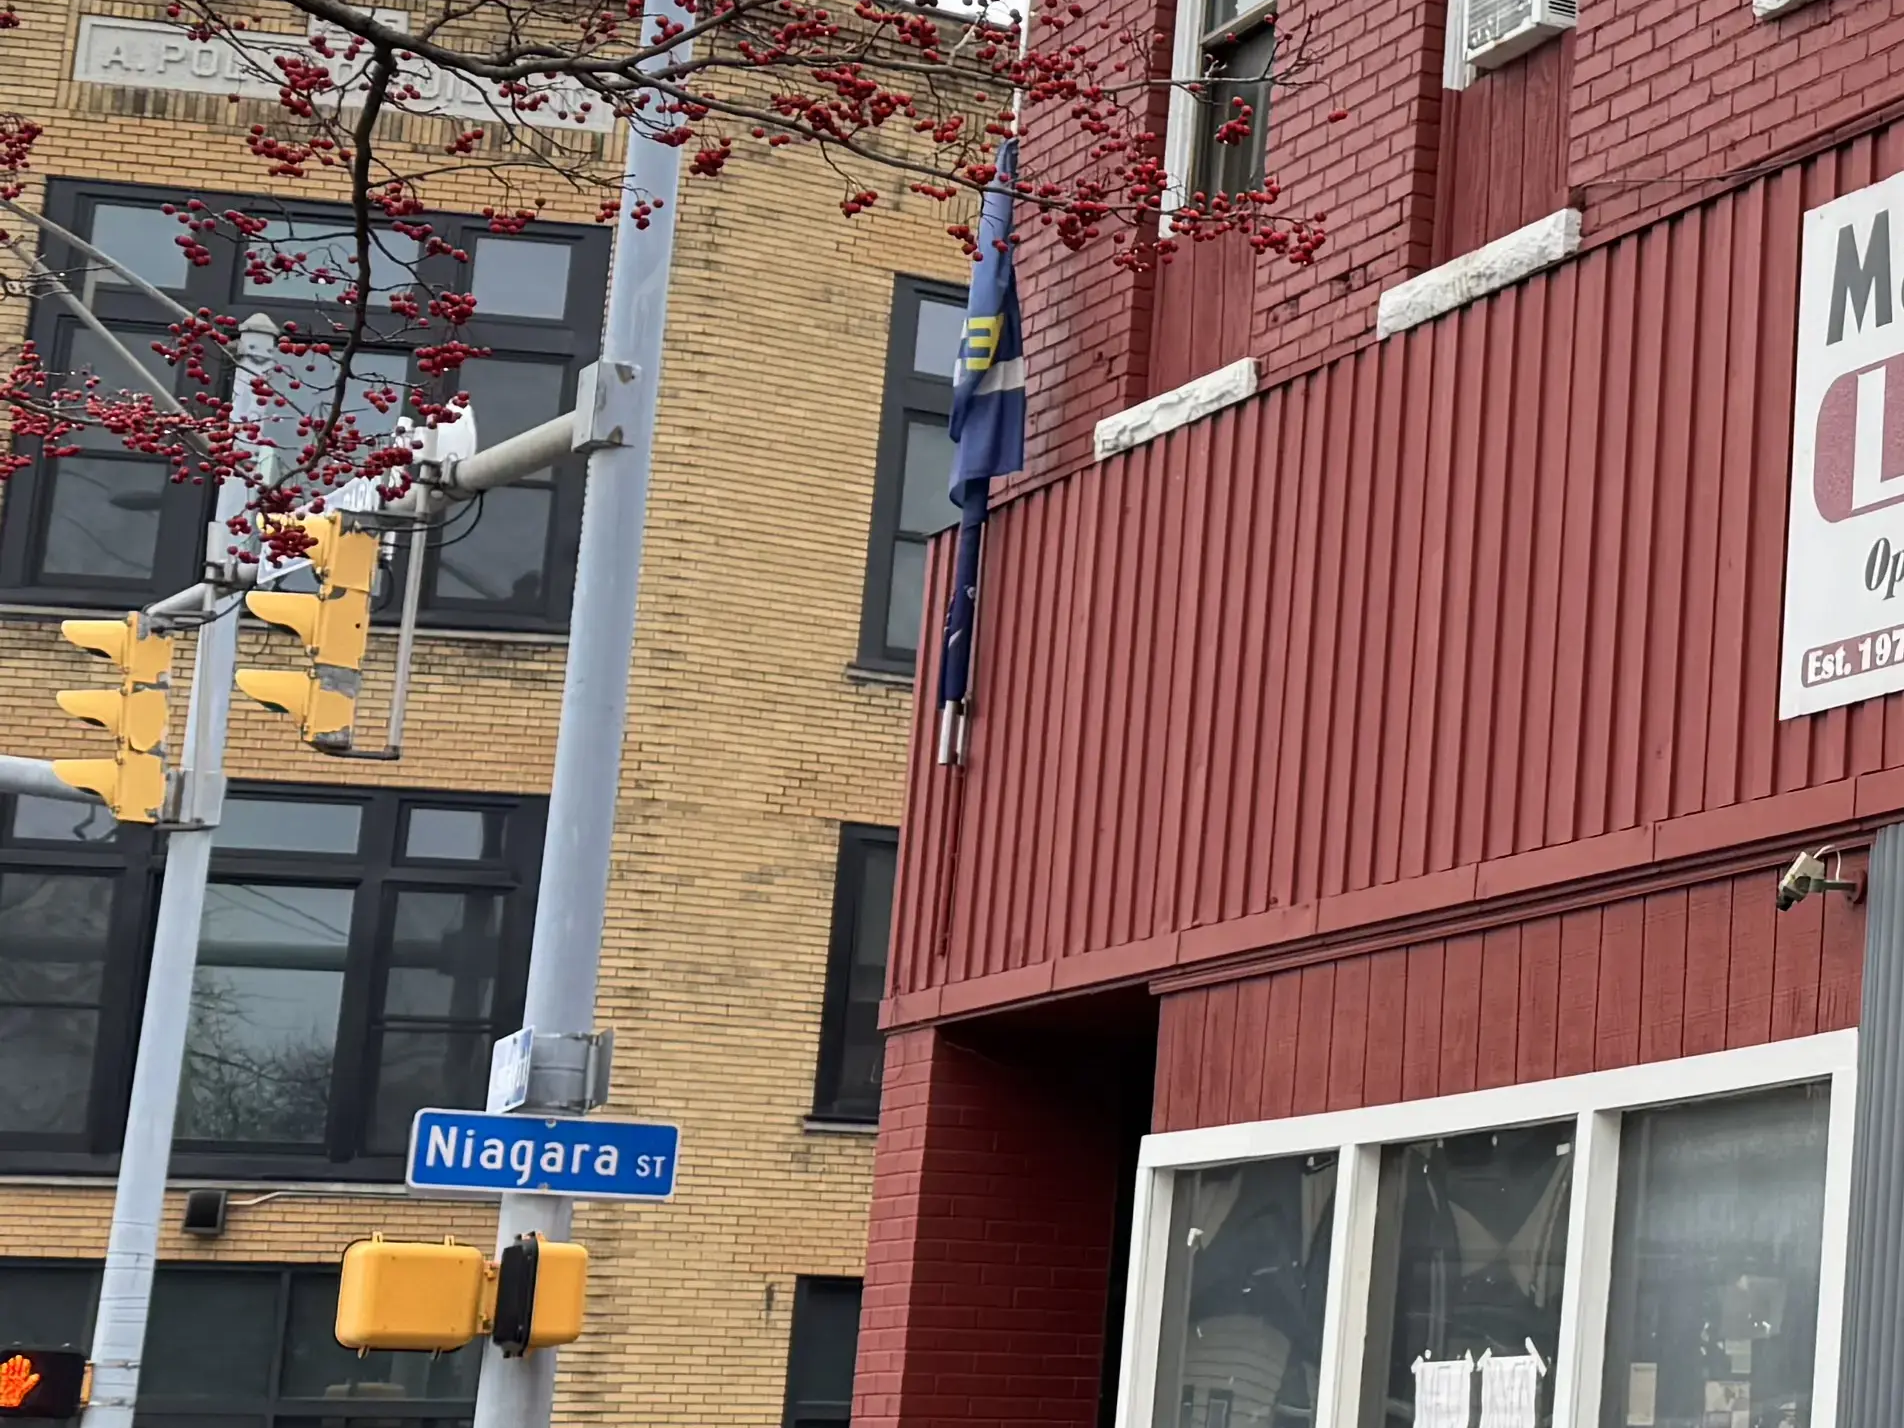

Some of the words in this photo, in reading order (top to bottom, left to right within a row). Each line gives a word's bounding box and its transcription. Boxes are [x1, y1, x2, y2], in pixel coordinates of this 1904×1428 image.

[1806, 649, 1852, 683] Est.
[425, 1124, 620, 1186] Niagara
[635, 1154, 667, 1179] ST
